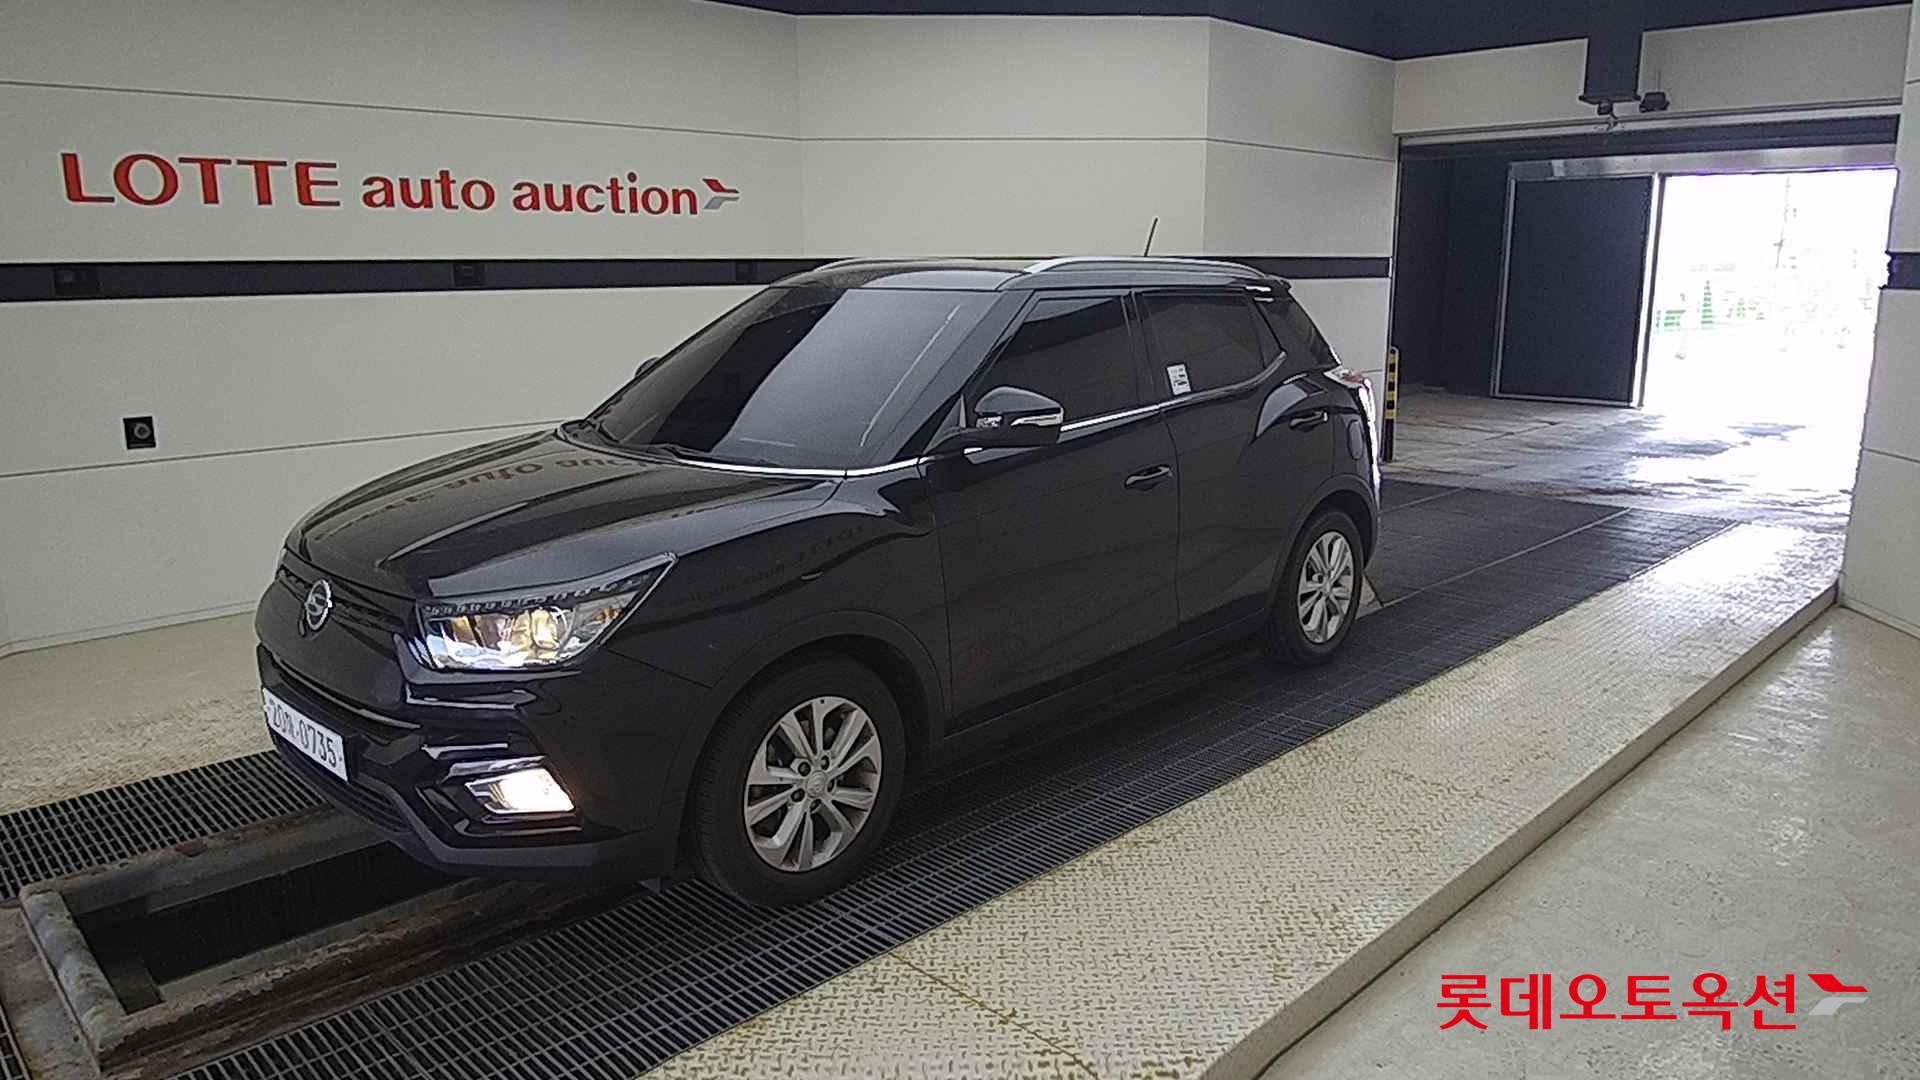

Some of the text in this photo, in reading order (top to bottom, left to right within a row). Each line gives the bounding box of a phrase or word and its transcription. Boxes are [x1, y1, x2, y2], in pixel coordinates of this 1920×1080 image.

[61, 152, 699, 216] LOTTE auto auction
